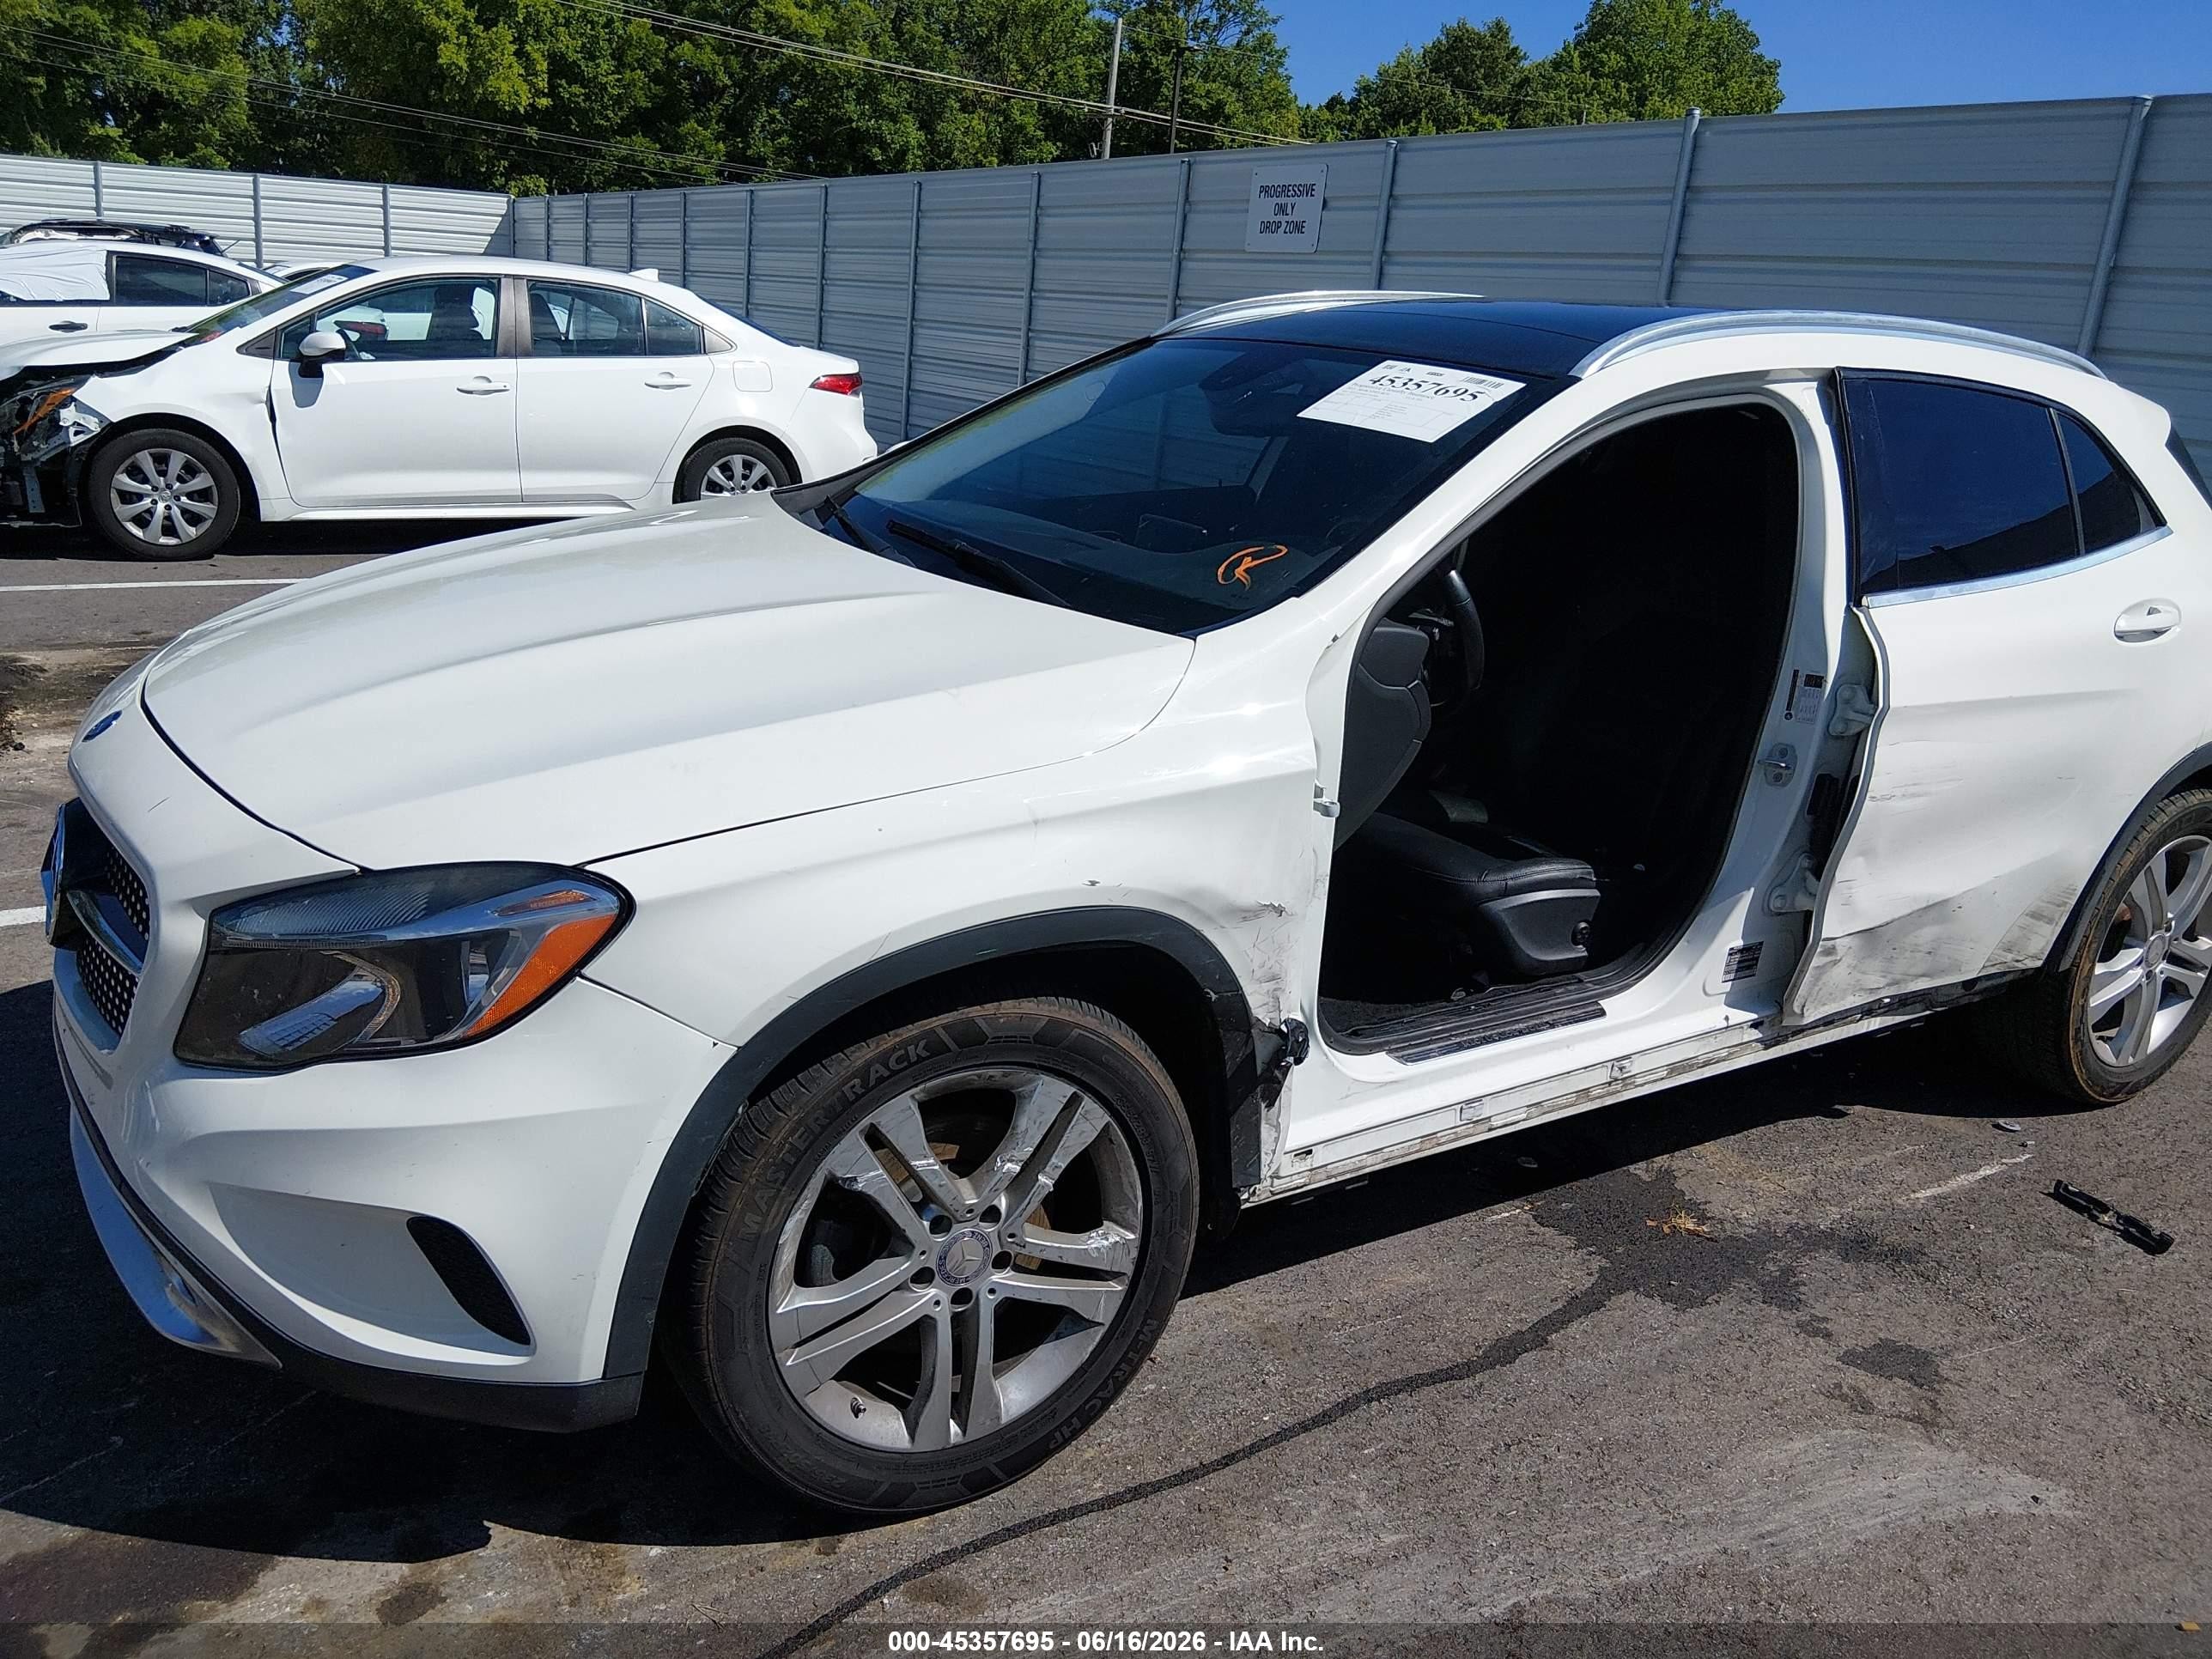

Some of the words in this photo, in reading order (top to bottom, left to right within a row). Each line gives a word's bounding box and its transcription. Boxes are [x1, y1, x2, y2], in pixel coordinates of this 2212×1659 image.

[1259, 184, 1316, 198] PROGRESSIVE
[1273, 203, 1296, 216] ONLY
[1259, 221, 1282, 234] DROP
[1283, 221, 1306, 234] ZONE
[1368, 374, 1486, 403] 45357695
[1049, 1416, 1082, 1449] HP
